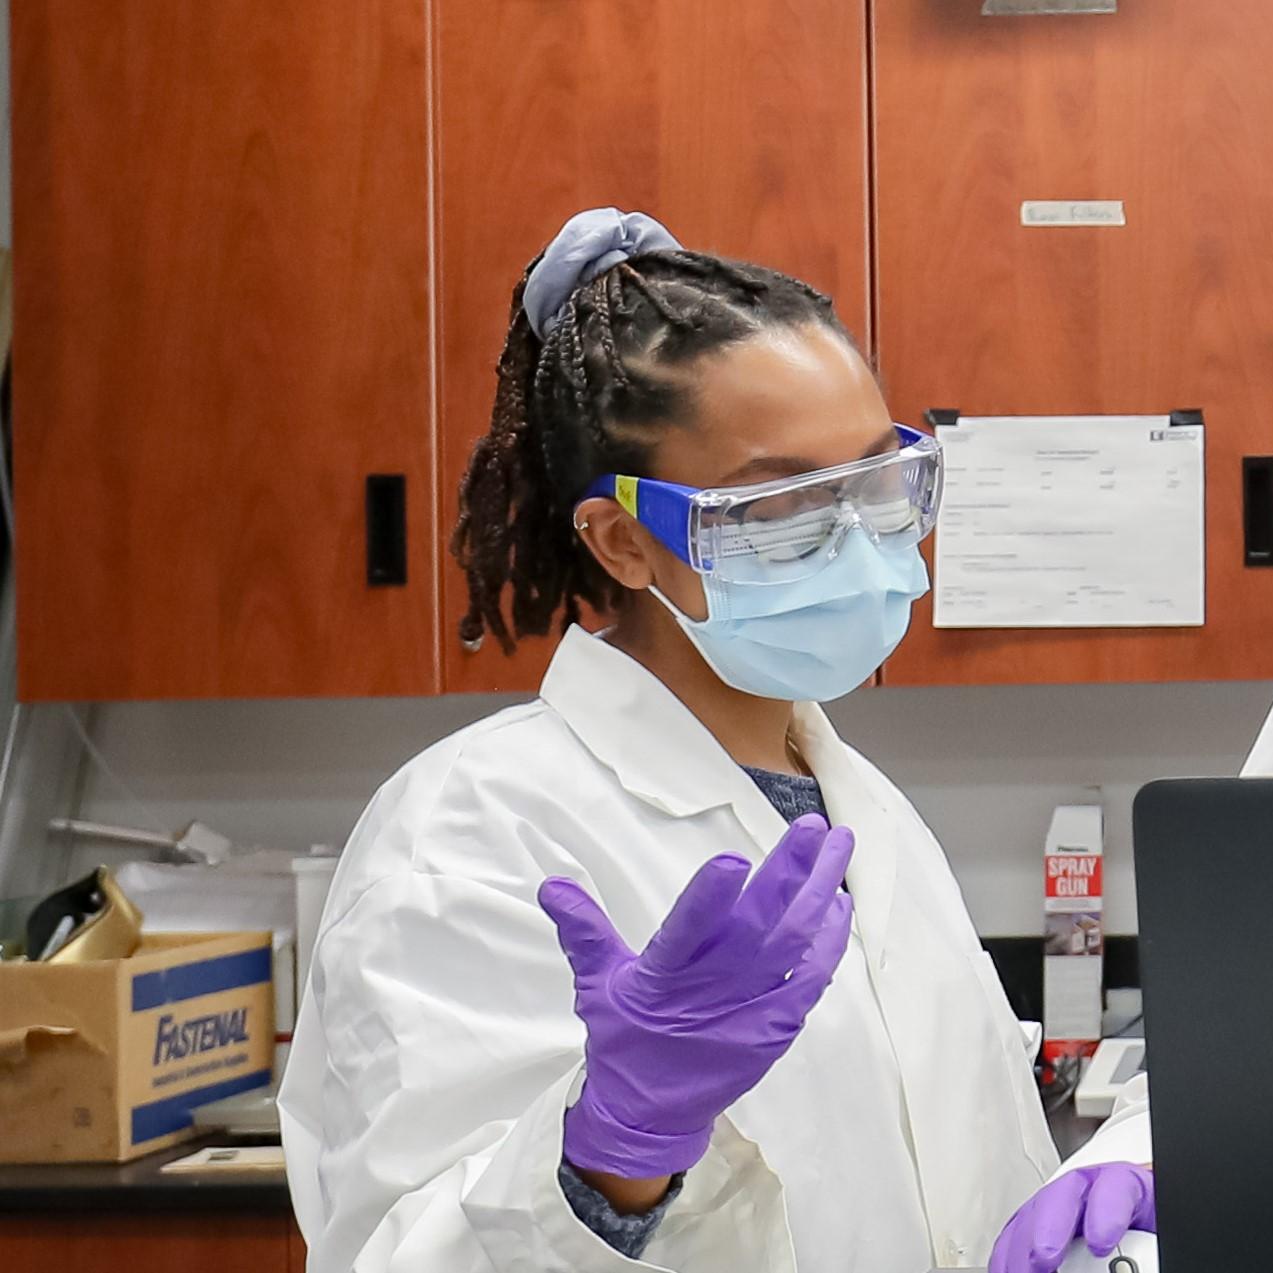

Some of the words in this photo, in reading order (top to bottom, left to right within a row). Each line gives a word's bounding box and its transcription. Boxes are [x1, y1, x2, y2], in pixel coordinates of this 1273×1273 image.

[1047, 857, 1097, 877] SPRAY
[1056, 876, 1089, 896] GUN
[152, 1007, 250, 1066] FASTENAL
